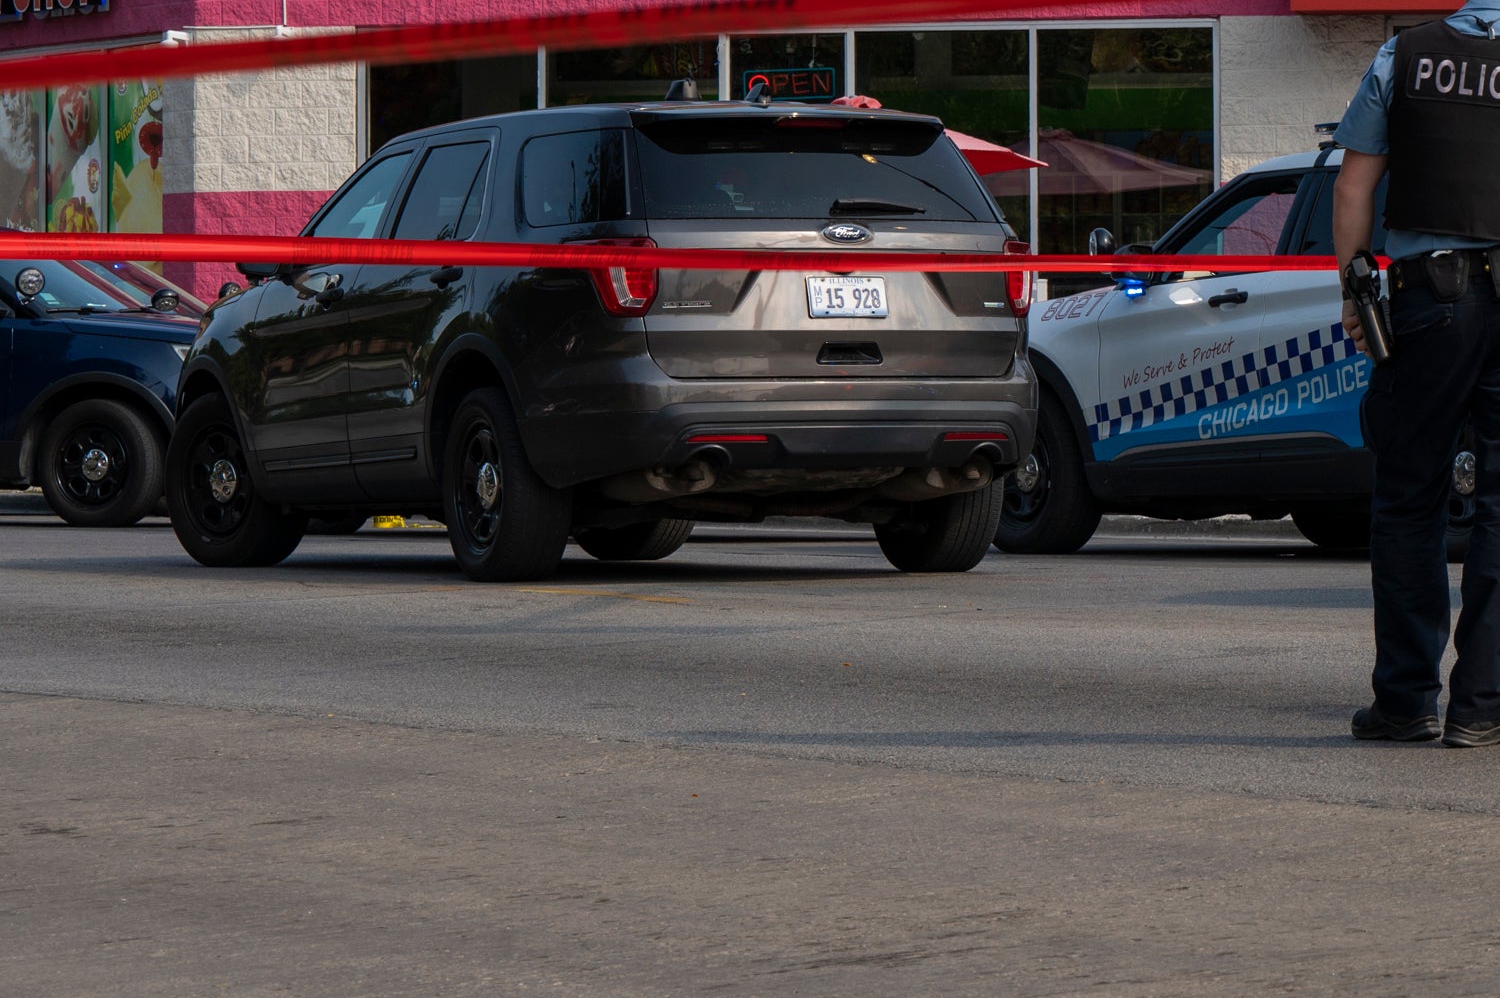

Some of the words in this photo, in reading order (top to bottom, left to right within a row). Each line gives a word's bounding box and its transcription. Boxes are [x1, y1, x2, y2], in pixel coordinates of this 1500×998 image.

[114, 121, 133, 145] Piña
[131, 88, 158, 126] Colada
[831, 226, 861, 239] Ford
[826, 288, 845, 309] 15
[852, 287, 882, 309] 928
[1040, 291, 1109, 323] 8027
[1123, 369, 1141, 390] We
[1143, 359, 1176, 383] Serve
[1177, 352, 1189, 371] &
[1192, 335, 1235, 366] Protect
[1197, 387, 1290, 440] CHICAGO
[1296, 359, 1369, 410] POLICE
